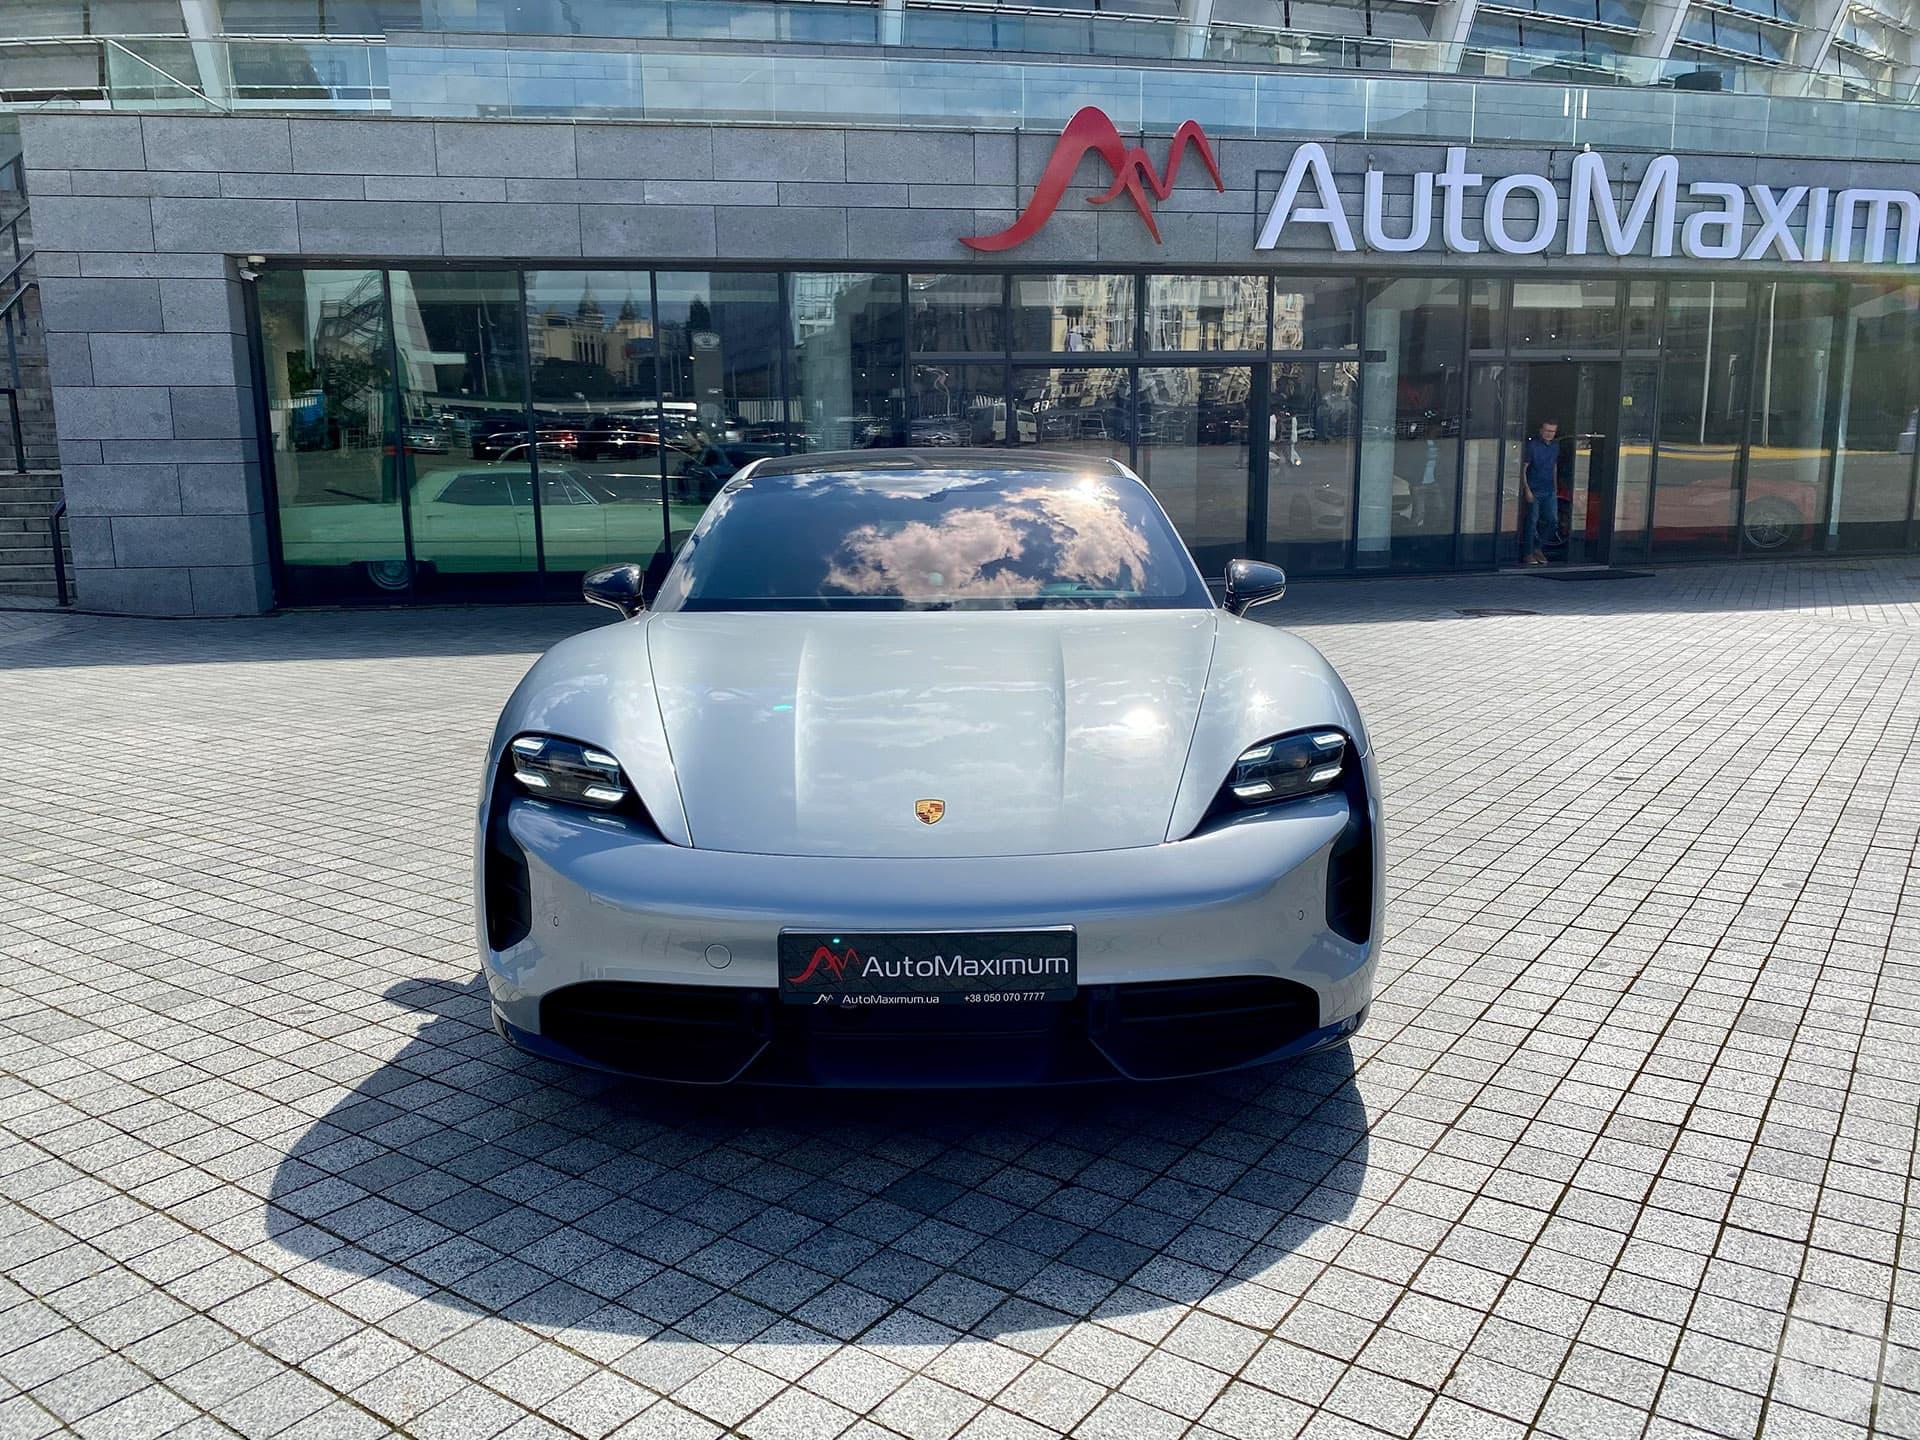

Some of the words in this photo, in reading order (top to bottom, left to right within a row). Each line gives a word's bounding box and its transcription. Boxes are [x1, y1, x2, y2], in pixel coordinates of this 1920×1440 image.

[861, 955, 1070, 978] AutoMaximum
[842, 994, 940, 1005] AutoMaximum.ua
[964, 993, 982, 1003] +38
[983, 993, 1001, 1003] 050
[1003, 992, 1021, 1002] 070
[1023, 992, 1046, 1001] 7777
